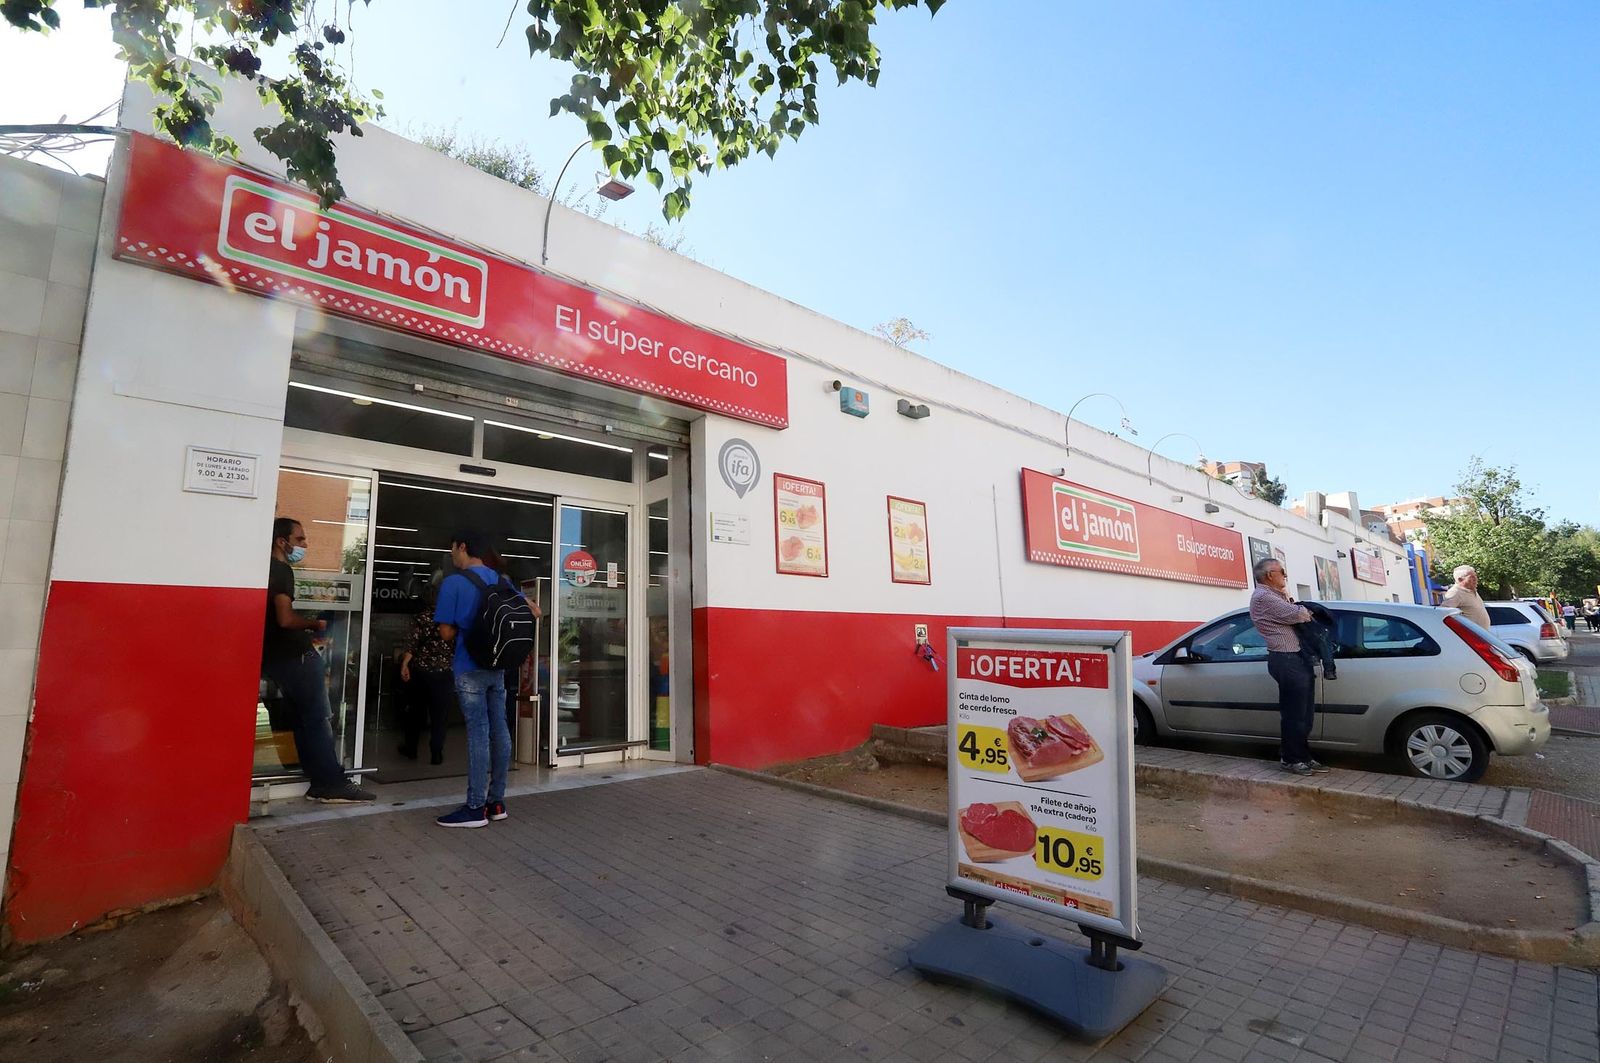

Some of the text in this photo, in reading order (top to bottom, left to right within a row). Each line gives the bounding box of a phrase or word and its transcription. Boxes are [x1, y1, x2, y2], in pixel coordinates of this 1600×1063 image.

[244, 209, 471, 303] el jamón
[555, 304, 758, 388] El súper cercano
[206, 456, 241, 465] HORARIO
[732, 460, 749, 477] ifa
[1061, 498, 1134, 543] el jamón
[1177, 534, 1186, 552] El
[1186, 536, 1207, 559] súper
[1208, 545, 1235, 561] cercano
[570, 560, 593, 568] ONLINE
[970, 654, 1082, 683] ¡OFERTA!
[959, 692, 1010, 704] Cinta de lomo
[970, 705, 992, 713] cerdo
[992, 705, 1017, 715] fresca
[1040, 797, 1097, 814] Filete de añojo
[1043, 808, 1064, 817] extra
[1065, 811, 1097, 825] (cadera)
